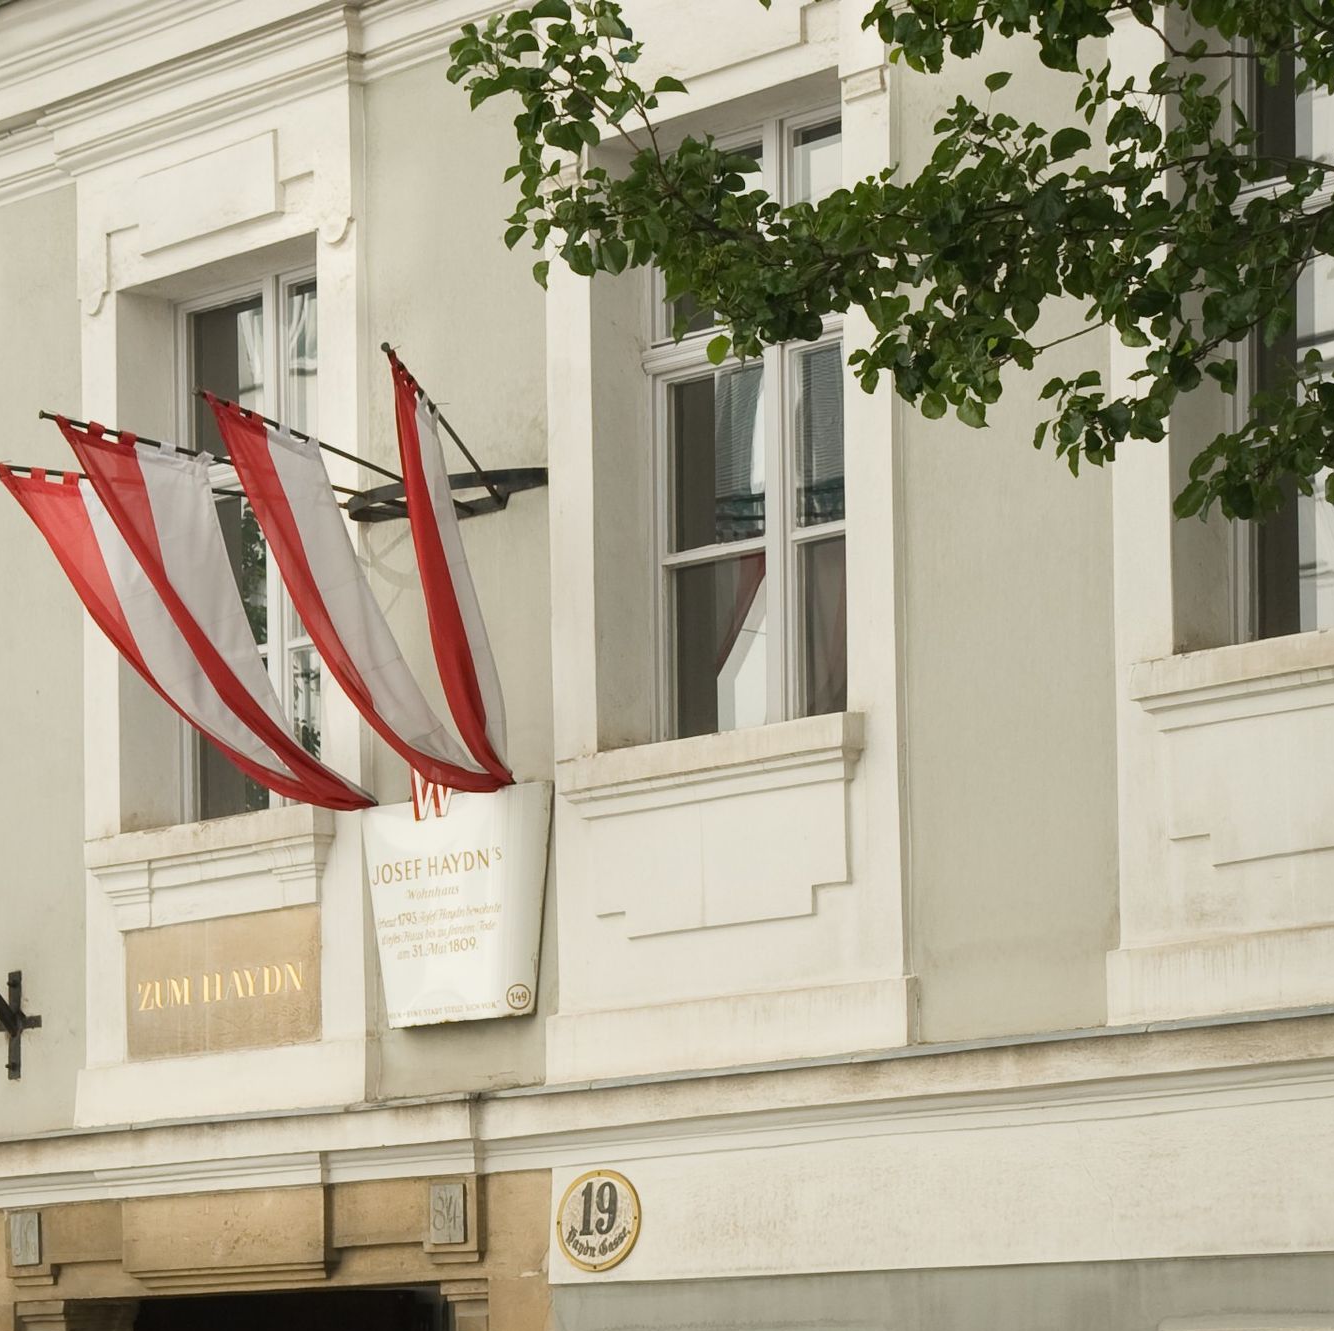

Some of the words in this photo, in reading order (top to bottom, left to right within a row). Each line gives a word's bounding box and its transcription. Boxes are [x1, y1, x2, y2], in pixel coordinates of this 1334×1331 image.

[411, 769, 452, 821] W
[372, 858, 422, 886] JOSEF
[406, 885, 459, 900] Wohnhaus
[138, 975, 191, 1011] ZUM
[202, 961, 305, 1004] HAYDN
[510, 991, 527, 1003] 149
[579, 1181, 618, 1236] 19
